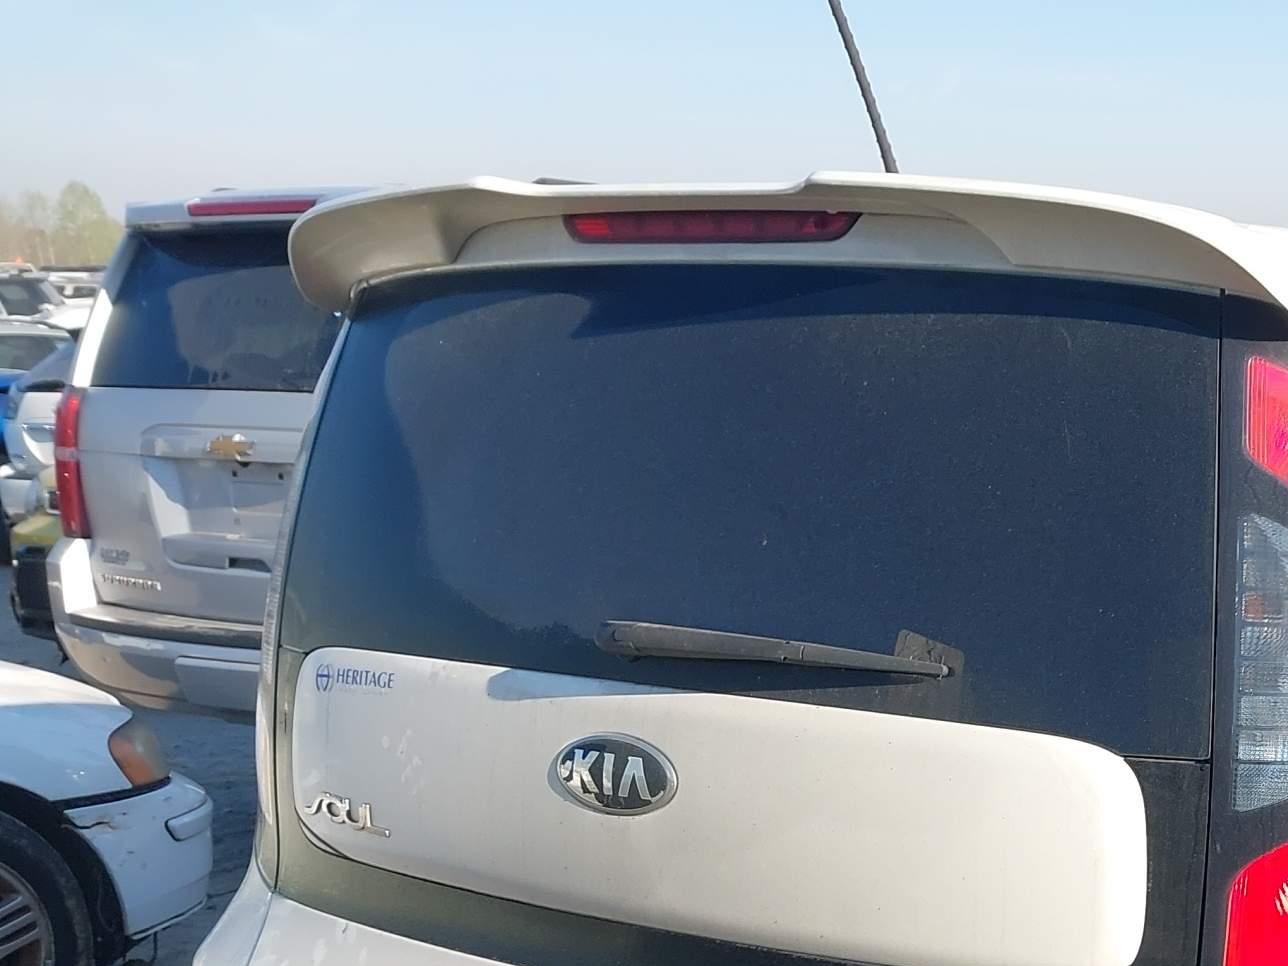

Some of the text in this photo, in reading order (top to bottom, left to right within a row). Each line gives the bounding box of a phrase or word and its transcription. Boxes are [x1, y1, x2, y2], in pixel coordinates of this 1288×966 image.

[336, 668, 395, 689] HERITAGE
[572, 749, 654, 802] KIA
[305, 792, 391, 839] SOUL
